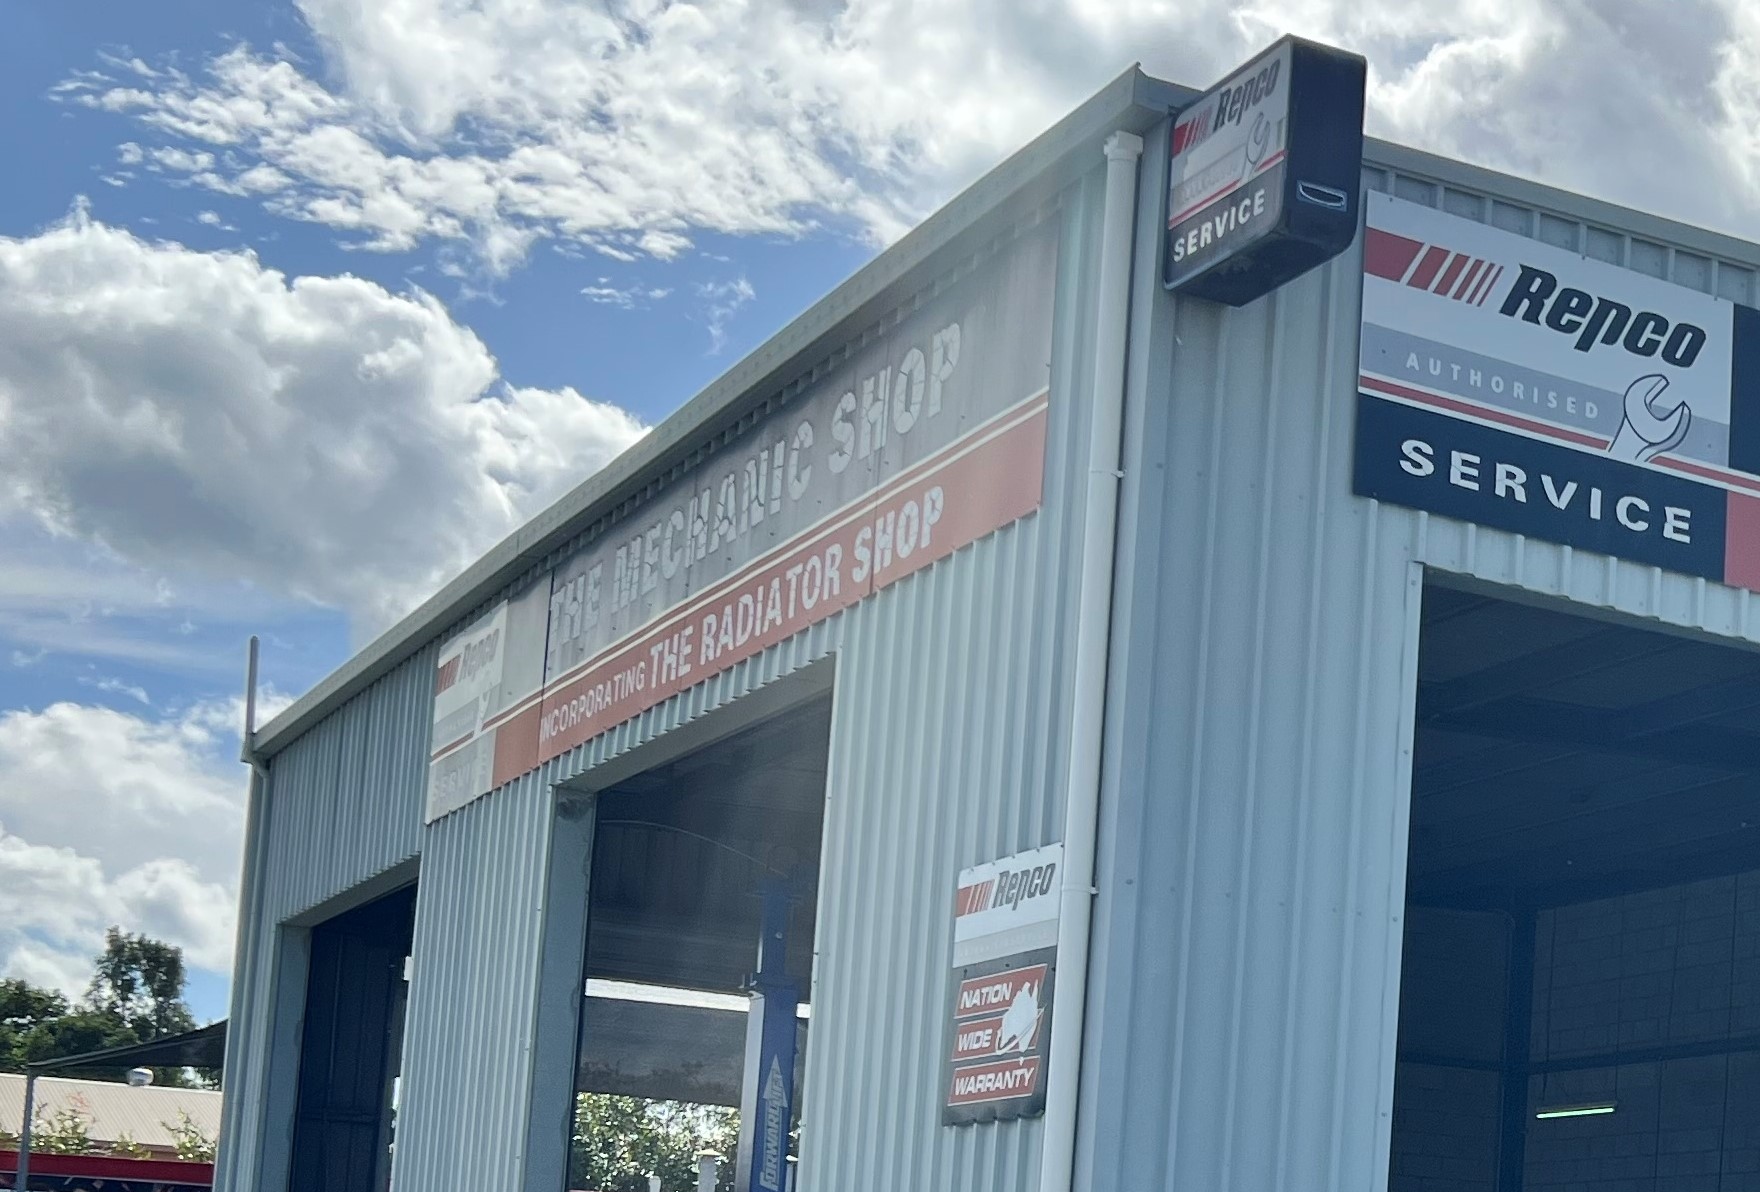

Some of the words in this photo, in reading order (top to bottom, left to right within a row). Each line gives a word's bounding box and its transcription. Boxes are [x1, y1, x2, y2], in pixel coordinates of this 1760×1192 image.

[1213, 58, 1281, 134] Repco
[1172, 188, 1266, 263] SERVICE
[1498, 263, 1707, 368] Repco
[1405, 351, 1600, 420] AUTHORISED
[550, 561, 603, 655] THE
[610, 421, 814, 615] MECHANIC
[827, 322, 962, 475] SHOP
[1399, 438, 1693, 544] SERVICE
[539, 660, 646, 743] INCORPORATING
[650, 625, 695, 690] THE
[700, 543, 843, 666] RADIATOR
[852, 485, 944, 584] SHOP
[991, 862, 1057, 911] Repco
[959, 981, 1013, 1010] NATION
[957, 1028, 993, 1053] WIDE
[954, 1066, 1035, 1096] WARRANTY
